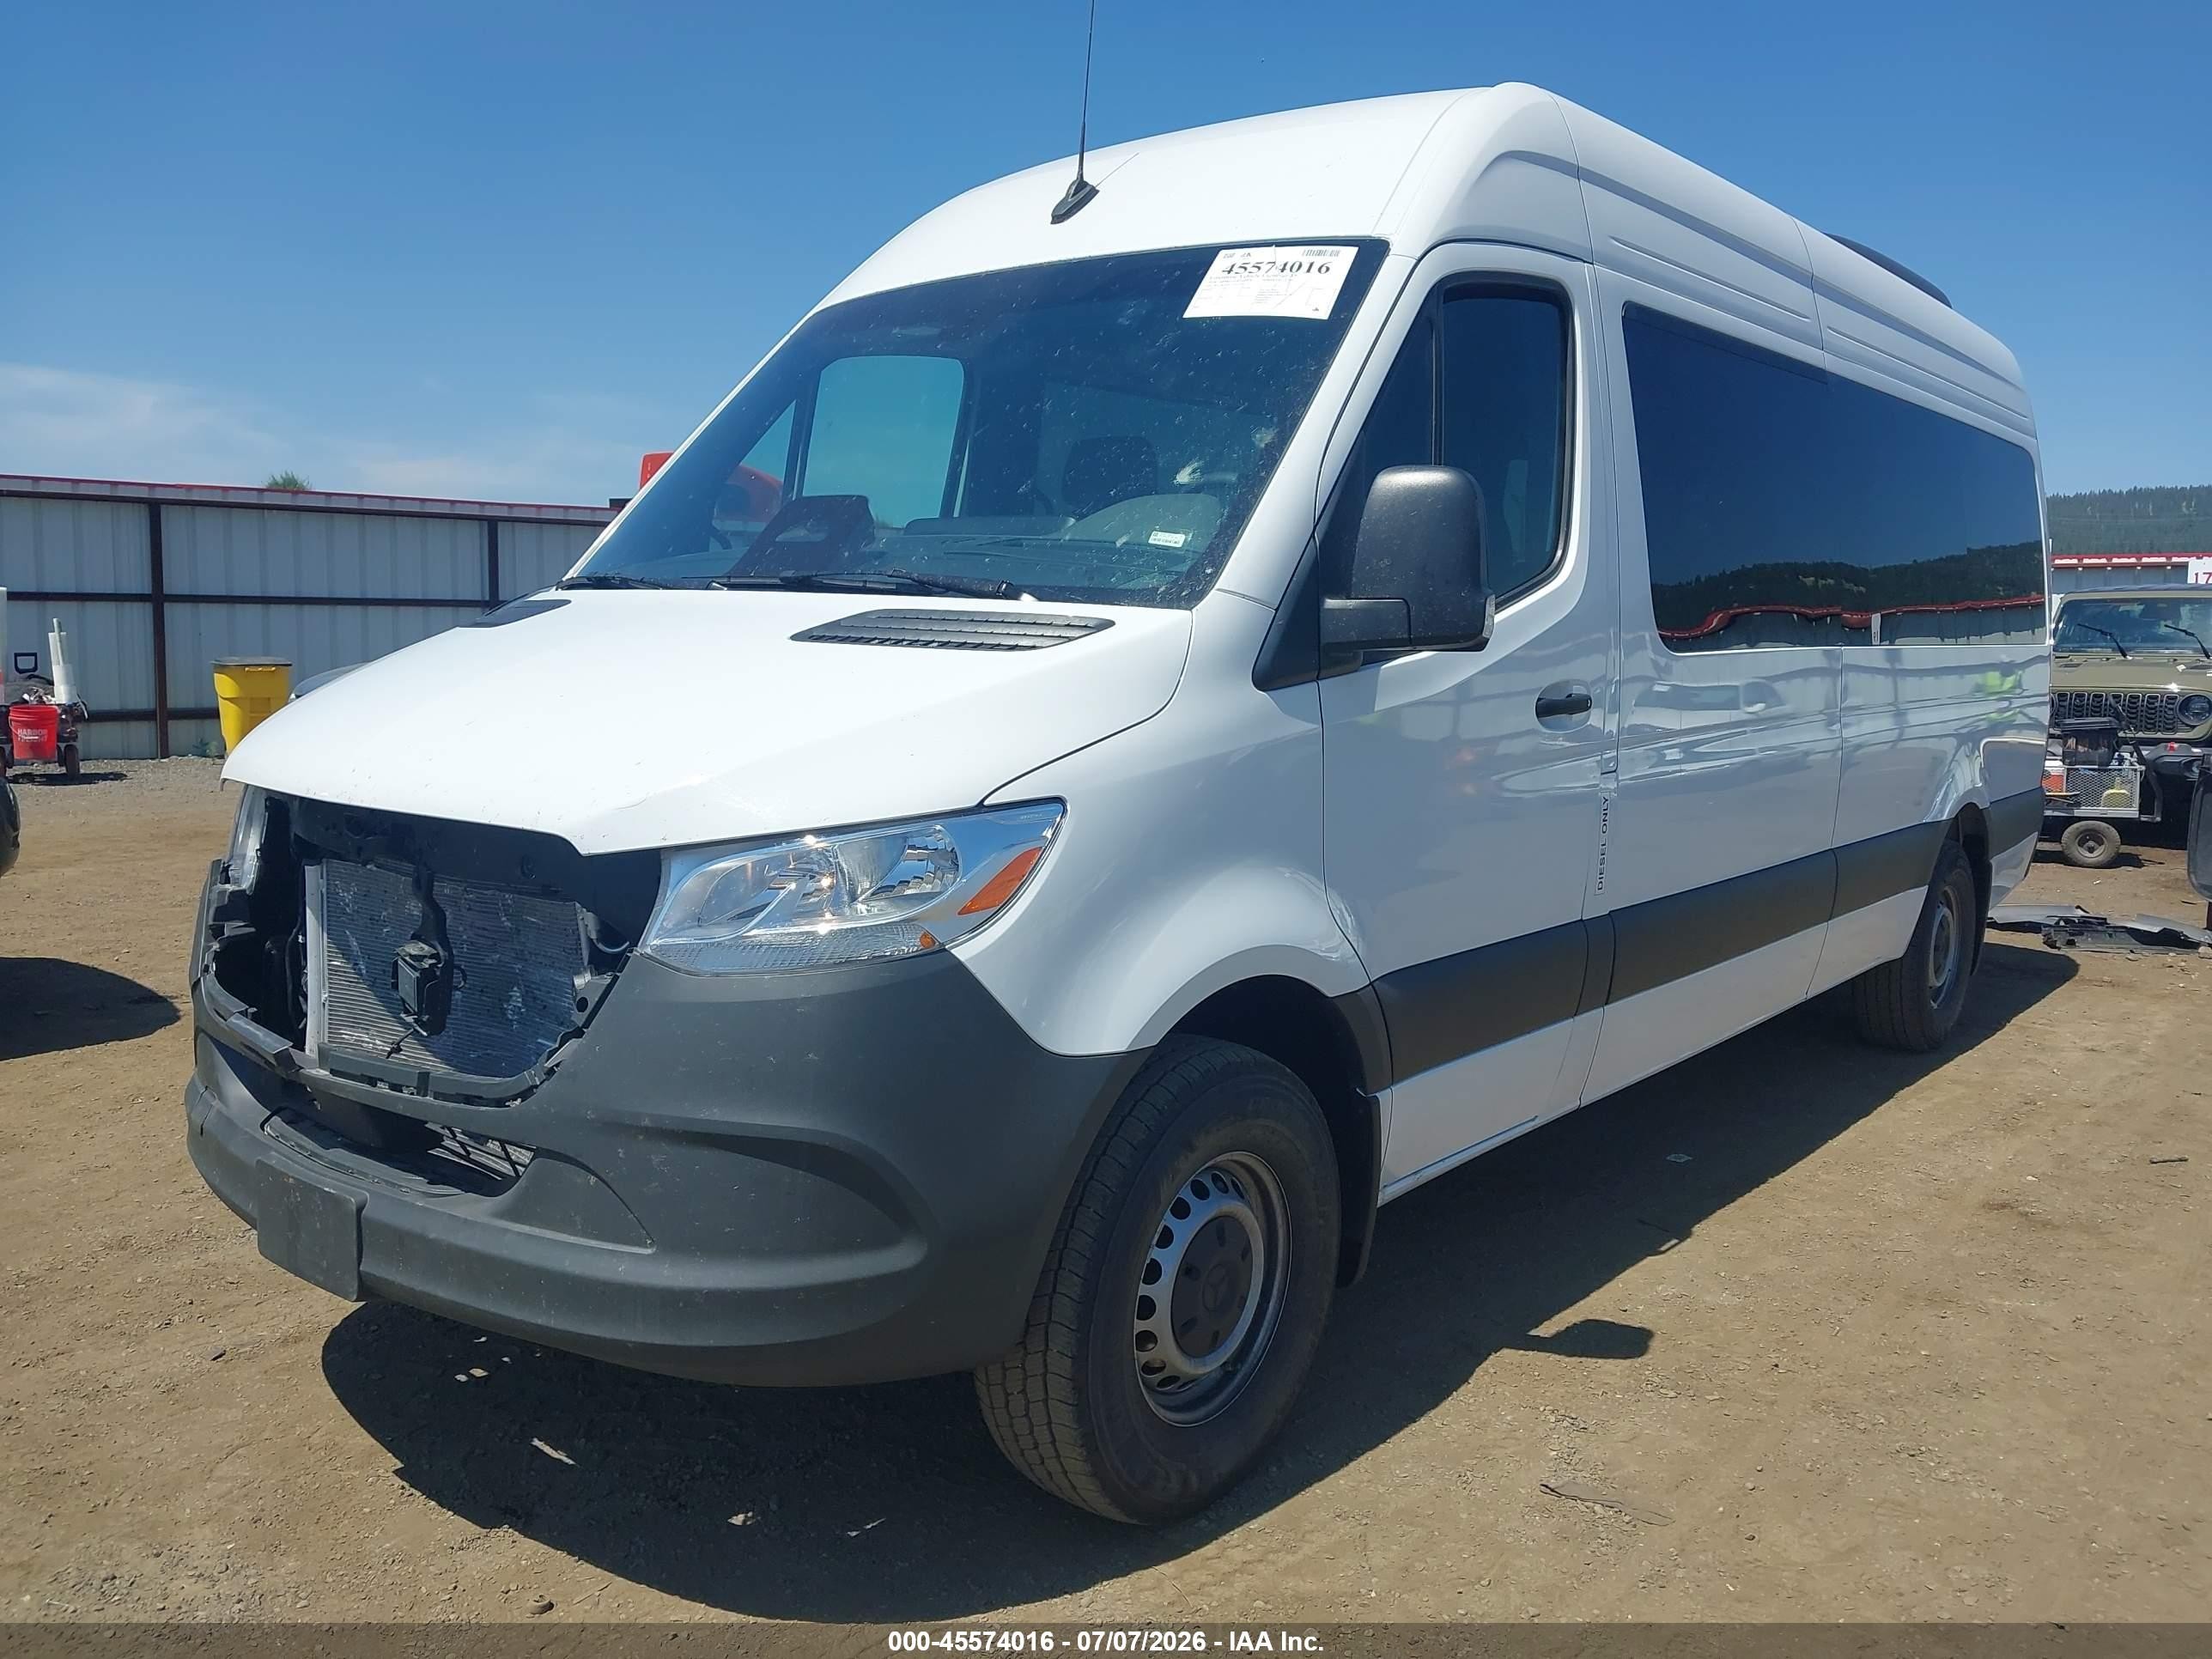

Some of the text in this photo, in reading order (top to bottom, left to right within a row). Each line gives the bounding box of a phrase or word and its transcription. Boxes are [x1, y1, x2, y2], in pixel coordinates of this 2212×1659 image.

[1222, 260, 1333, 276] 45574016
[1597, 796, 1610, 890] DIESEL ONLY
